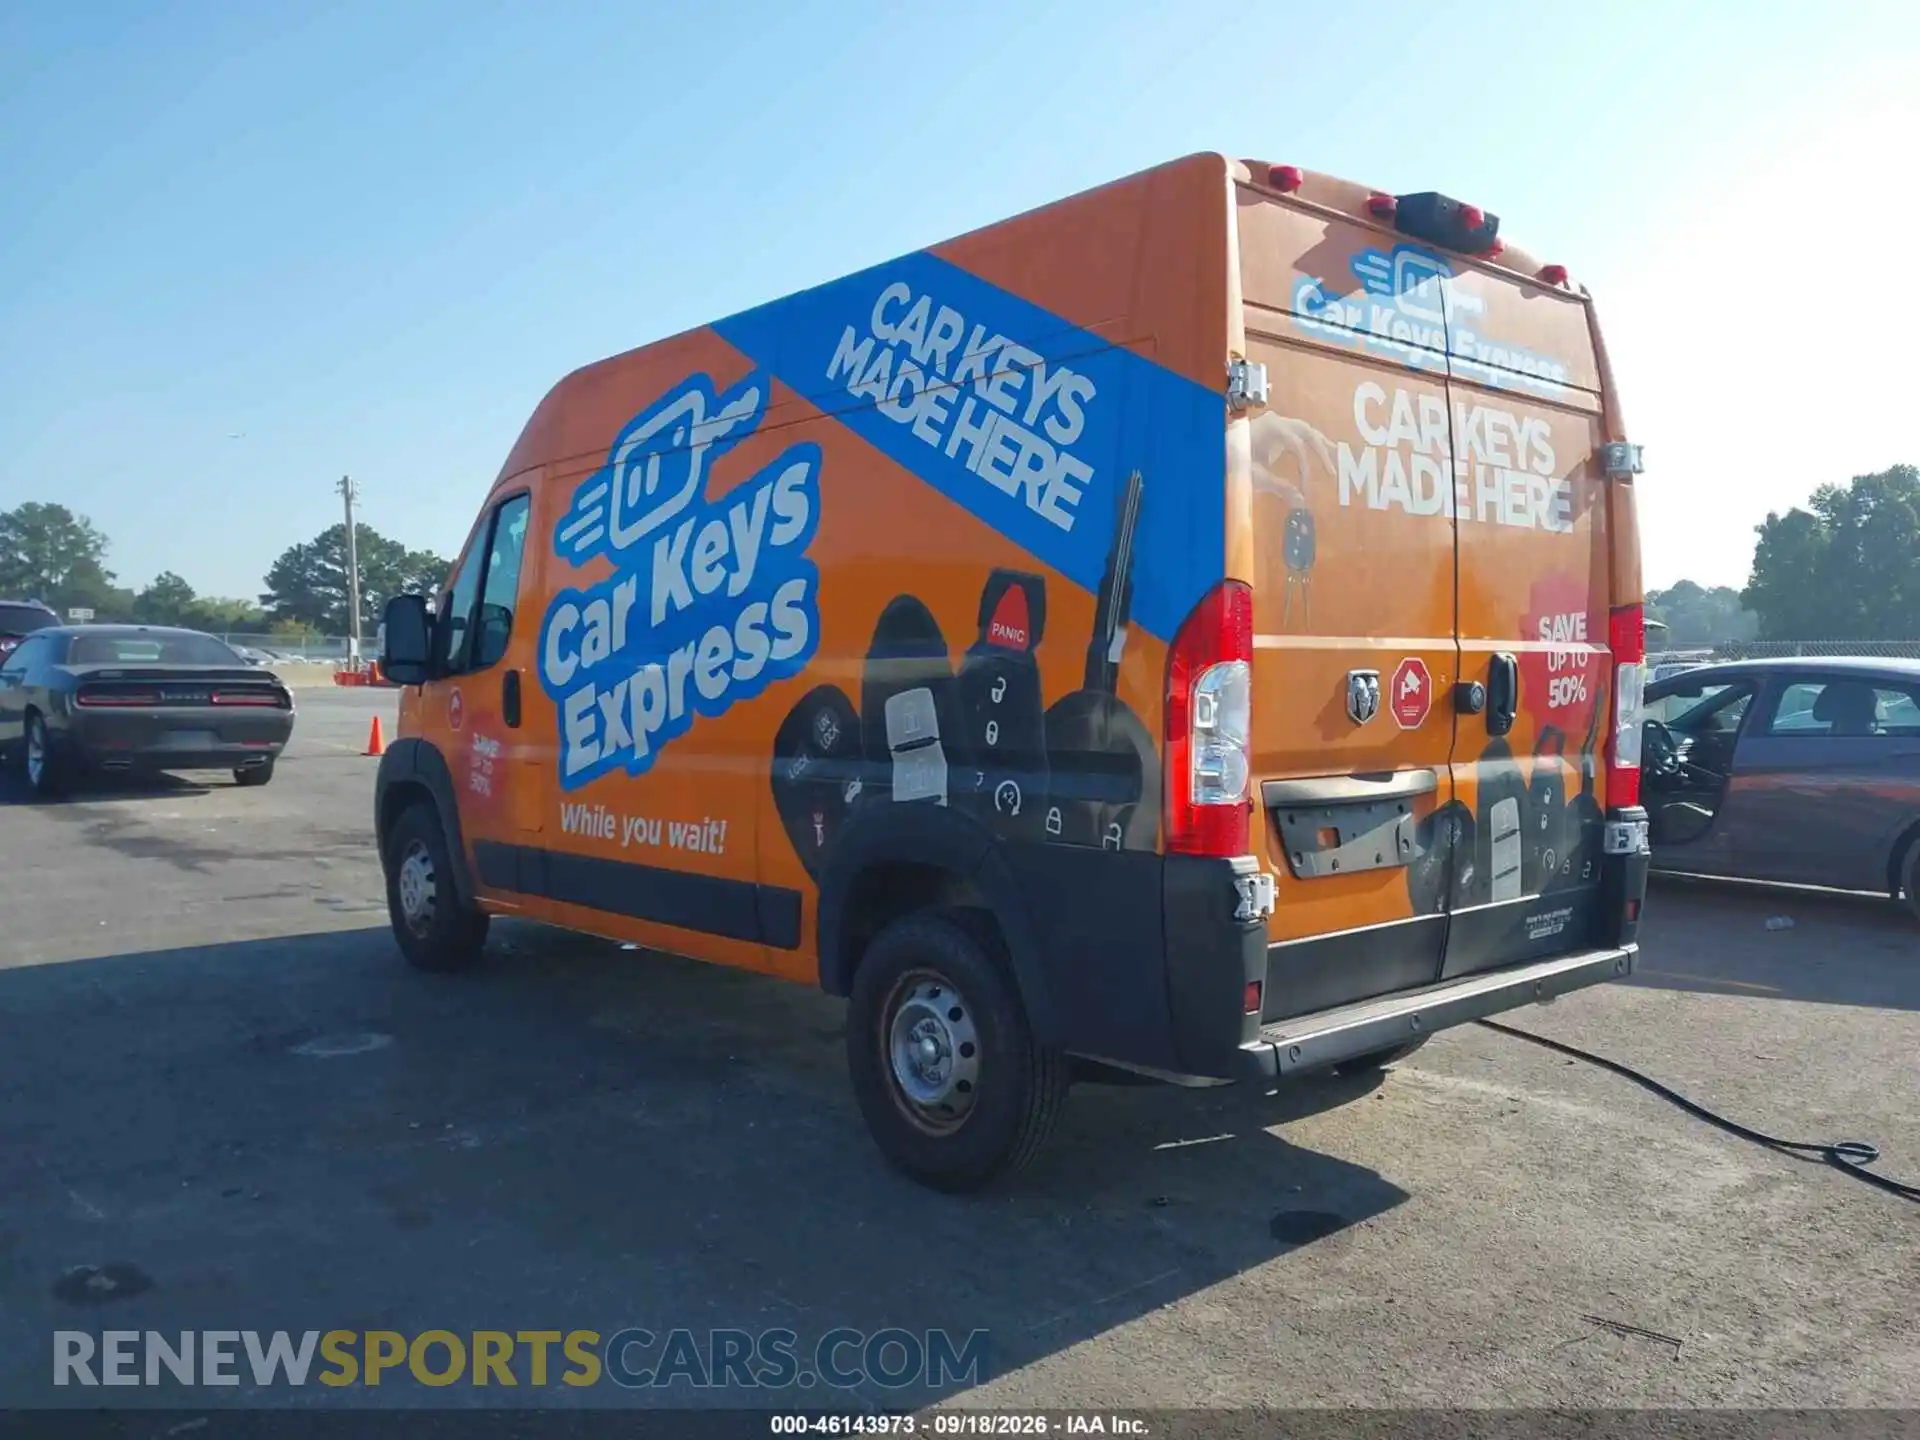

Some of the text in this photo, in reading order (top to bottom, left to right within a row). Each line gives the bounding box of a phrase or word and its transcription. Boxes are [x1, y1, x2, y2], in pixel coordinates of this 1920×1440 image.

[1296, 284, 1362, 337] Car
[1368, 303, 1445, 363] Keys
[870, 282, 1097, 446] CAR KEYS
[826, 325, 1095, 532] MADE HERE
[1354, 381, 1556, 475] CAR KEYS
[1337, 441, 1573, 534] MADE HERE
[545, 462, 811, 686] Car Keys
[992, 622, 1025, 643] PANIC
[1539, 612, 1587, 643] SAVE
[565, 579, 809, 777] Express
[1548, 650, 1566, 672] UP
[1548, 673, 1587, 709] 50%
[788, 753, 812, 779] LOCK
[820, 724, 840, 750] LOCK
[560, 802, 728, 854] While you wait!
